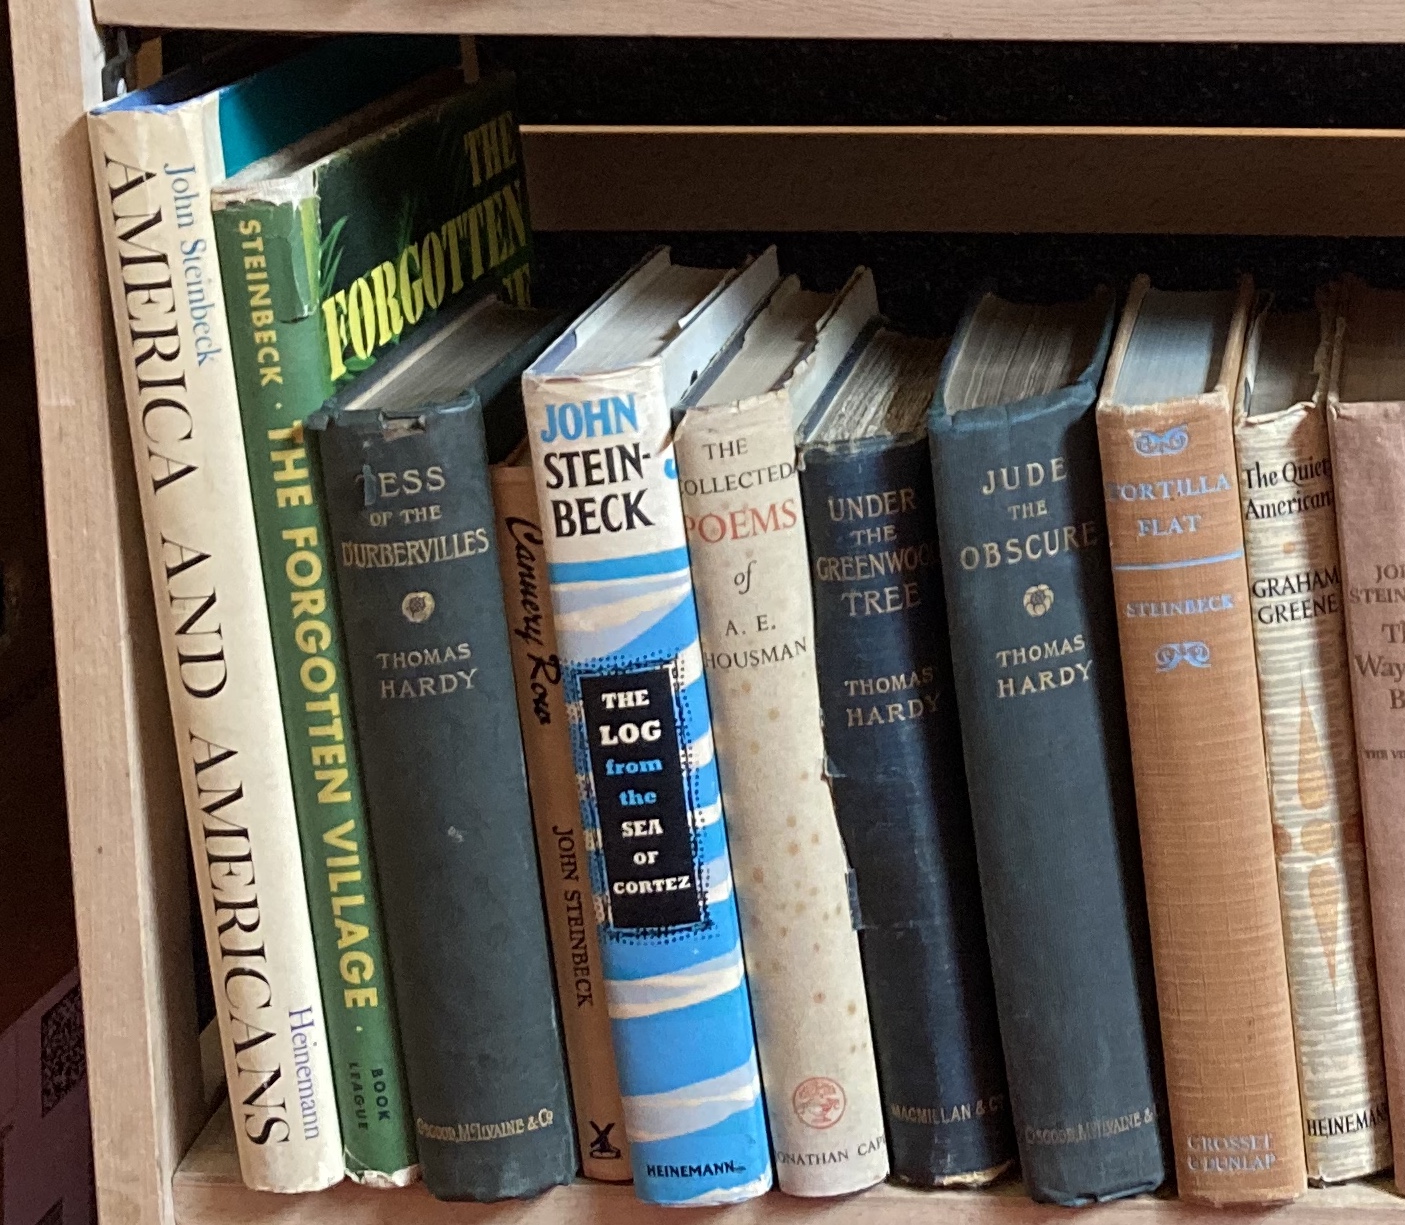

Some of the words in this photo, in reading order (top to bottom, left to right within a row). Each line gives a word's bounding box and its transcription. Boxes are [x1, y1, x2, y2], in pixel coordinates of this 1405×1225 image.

[163, 162, 200, 230] John
[321, 180, 528, 382] FORGOTTEN
[179, 239, 224, 367] Steinbeck
[238, 219, 283, 387] STEINBECK
[104, 151, 200, 496] AMERICA
[540, 394, 639, 444] JOHN
[267, 419, 315, 509] THE
[543, 444, 652, 491] STEIN-
[702, 437, 749, 461] THE
[981, 456, 1070, 496] JUDE
[1242, 461, 1279, 490] The
[551, 488, 655, 539] BECK
[827, 487, 917, 523] UNDER
[1007, 498, 1049, 522] THE
[851, 524, 897, 548] THE
[733, 560, 757, 595] of
[162, 532, 229, 700] AND
[841, 582, 922, 618] TREE
[1256, 594, 1338, 625] GREENE
[282, 528, 351, 806] FORGOTTEN
[376, 643, 472, 670] THOMAS
[995, 633, 1086, 669] THOMAS
[379, 667, 478, 700] HARDY
[996, 659, 1095, 699] HARDY
[602, 689, 650, 710] THE
[599, 719, 662, 746] LOG
[605, 756, 663, 776] from
[619, 786, 658, 807] the
[621, 818, 664, 838] SEA
[552, 825, 579, 885] JOHN
[612, 876, 692, 896] CORTEZ
[324, 818, 379, 1009] VILLAGE
[187, 729, 293, 1147] AMERICANS
[563, 888, 595, 1009] STEINBECK
[288, 1004, 321, 1140] Heinemann
[371, 1067, 391, 1122] BOOK
[646, 1158, 734, 1178] HEINEMANN
